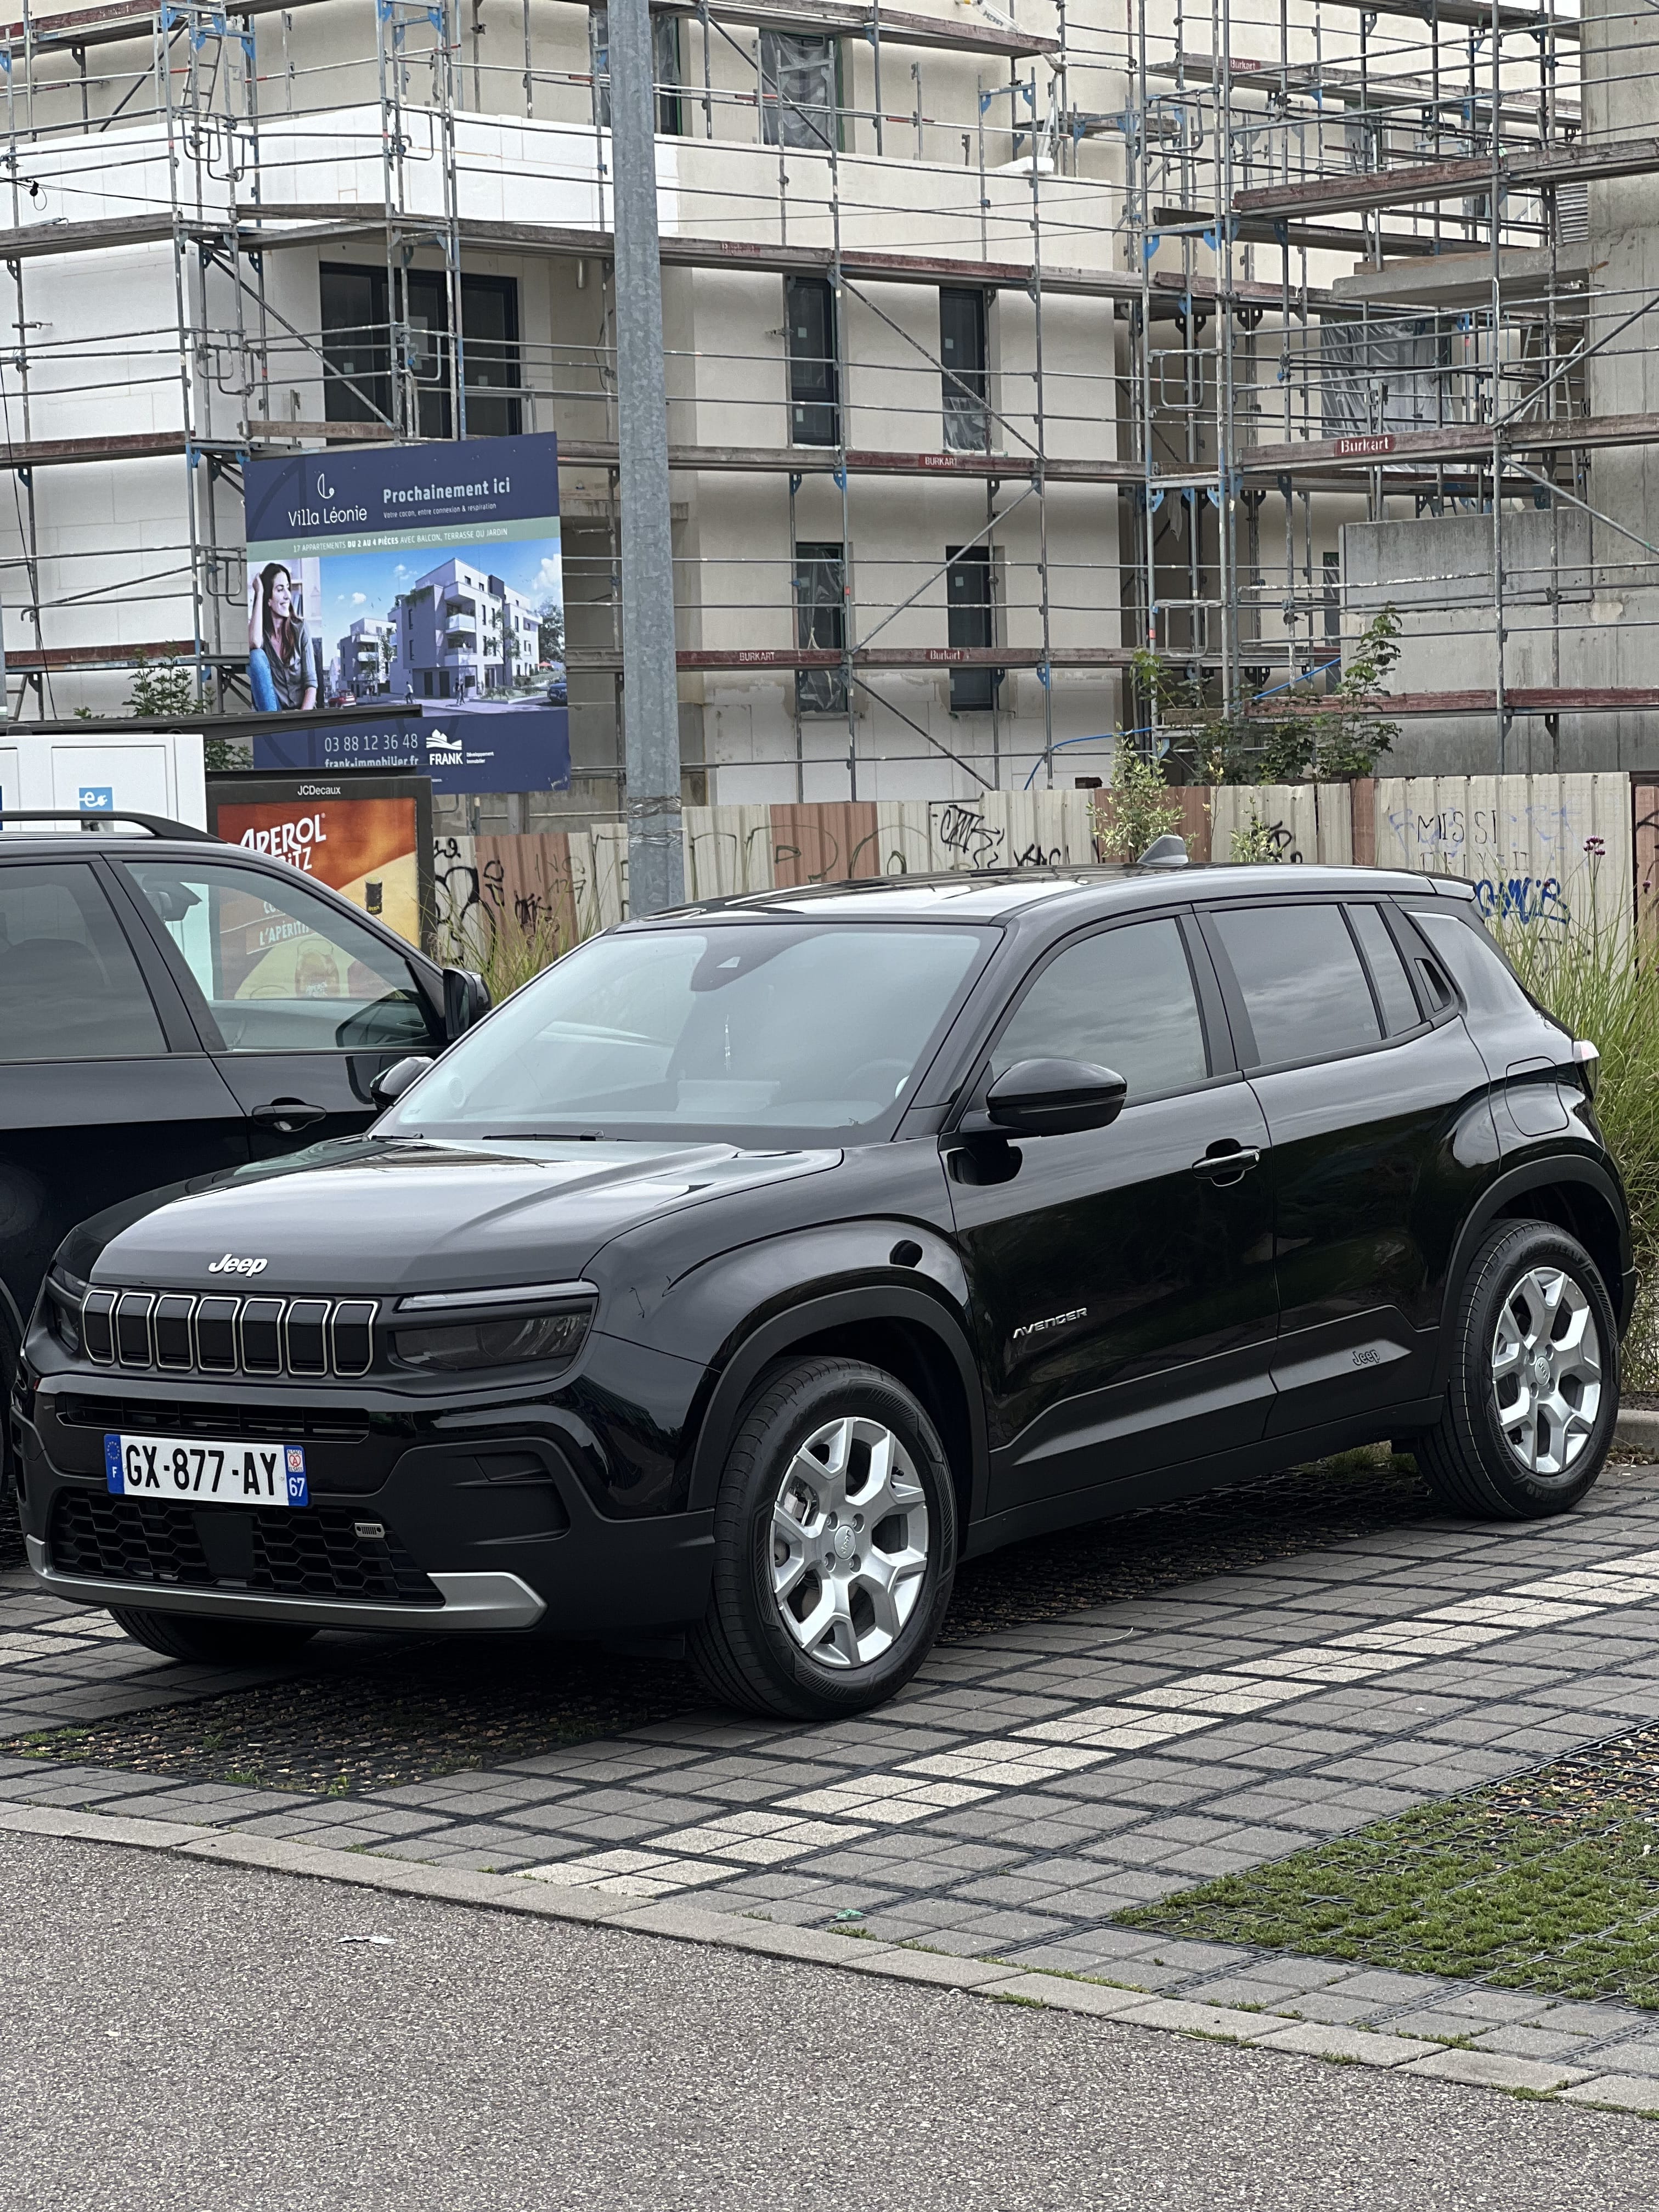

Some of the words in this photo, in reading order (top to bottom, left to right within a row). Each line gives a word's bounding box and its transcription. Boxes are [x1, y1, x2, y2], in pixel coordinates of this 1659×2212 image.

[1230, 59, 1255, 70] Burkart
[1341, 437, 1389, 453] Burkart
[925, 456, 957, 466] BURKART
[383, 480, 489, 504] Prochainement
[494, 477, 510, 494] ici
[288, 509, 320, 527] Villa
[324, 505, 367, 524] Léonie
[433, 505, 460, 515] connexion
[467, 503, 496, 511] respiration
[294, 545, 300, 553] 17
[302, 541, 346, 551] APPARTEMENTS
[378, 535, 398, 545] PIÈCES
[400, 535, 415, 544] AVEC
[417, 532, 443, 543] BALCON,
[444, 531, 474, 540] TERRASSE
[487, 528, 508, 537] JARDIN
[740, 652, 775, 661] BURKART
[930, 650, 960, 660] Burkart
[325, 737, 339, 752] 03
[344, 736, 359, 752] 88
[364, 735, 378, 751] 12
[383, 734, 398, 749] 36
[402, 733, 418, 749] 48
[429, 752, 464, 765] FRANK
[297, 785, 341, 795] JCDecaux
[240, 814, 327, 856] APEROL
[208, 1254, 268, 1278] Jeep
[1013, 1307, 1087, 1339] AVENGER
[1352, 1350, 1380, 1365] Jeep
[112, 1466, 117, 1479] F
[125, 1444, 277, 1496] GX-877-AY
[289, 1477, 305, 1497] 67
